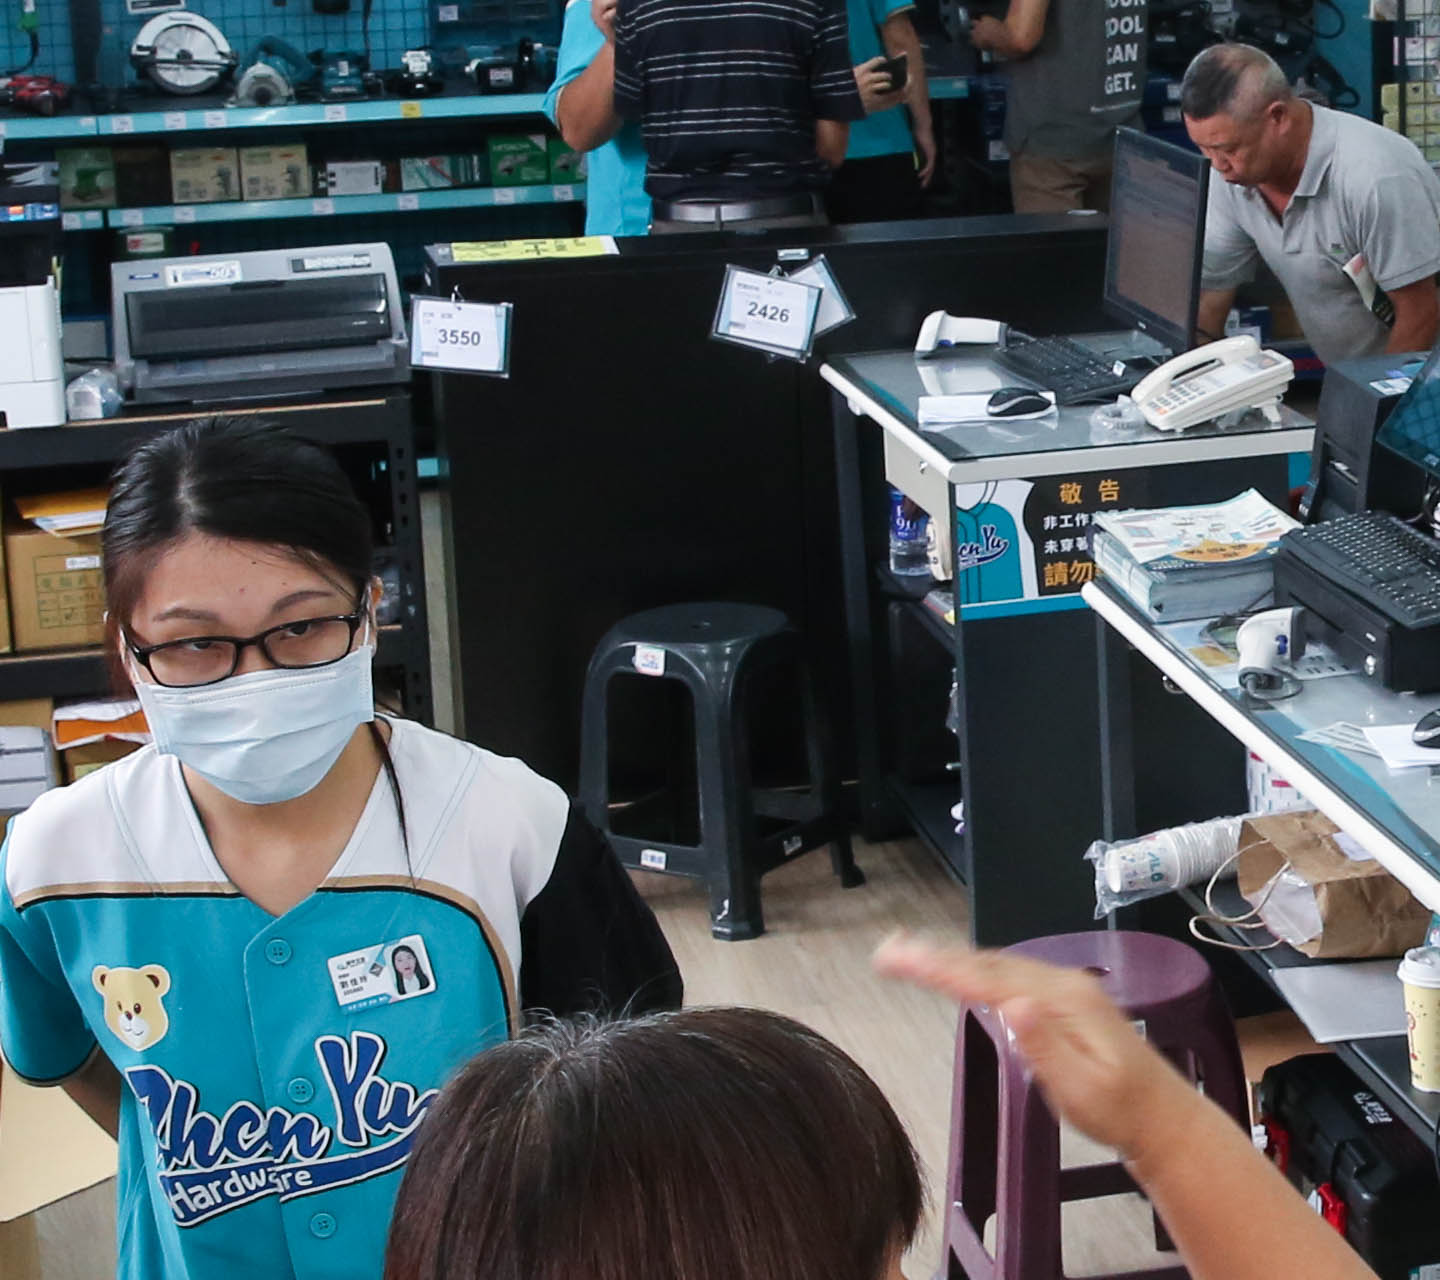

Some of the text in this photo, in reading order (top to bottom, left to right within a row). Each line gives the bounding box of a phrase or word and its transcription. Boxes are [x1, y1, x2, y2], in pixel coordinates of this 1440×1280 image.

[1104, 71, 1137, 96] GET.
[747, 300, 791, 323] 2426
[438, 328, 481, 346] 3550
[1060, 479, 1121, 506] 敬告
[1043, 561, 1103, 588] 請勿
